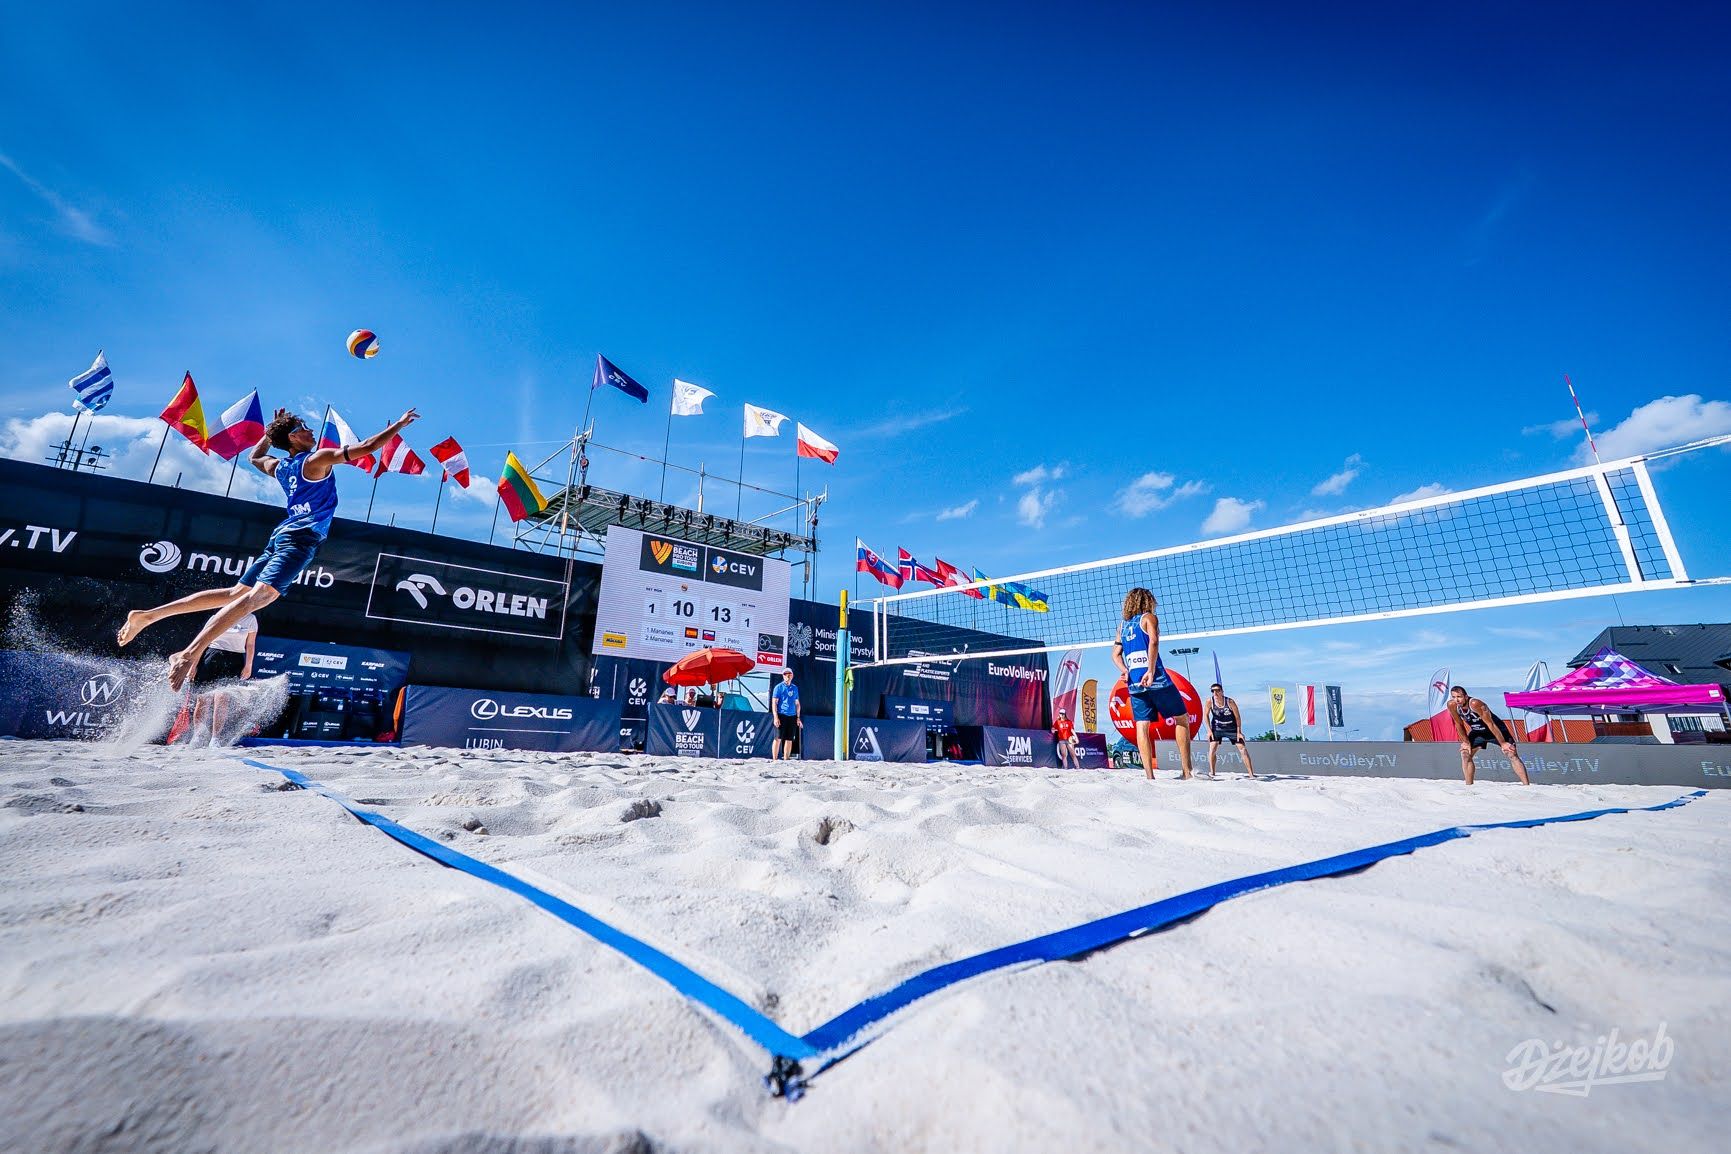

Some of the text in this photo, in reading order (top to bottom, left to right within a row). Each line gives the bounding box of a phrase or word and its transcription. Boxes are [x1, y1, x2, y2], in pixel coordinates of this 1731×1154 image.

[730, 562, 755, 576] CEV
[452, 586, 547, 619] ORLEN
[648, 603, 655, 613] 1
[673, 600, 694, 617] 10
[711, 606, 731, 623] 13
[744, 618, 750, 628] 1
[815, 640, 836, 651] Sport
[1133, 657, 1148, 665] cap
[988, 662, 1047, 683] EuroVolley.TV
[628, 697, 647, 706] CEV
[500, 704, 573, 720] LEXUS
[620, 728, 632, 736] CZ
[465, 738, 504, 750] LUBIN
[675, 735, 704, 744] BEACH
[1008, 736, 1032, 755] ZAM
[735, 745, 754, 754] CEV
[1074, 747, 1086, 760] ap
[1009, 755, 1033, 763] SERVICES
[1299, 753, 1397, 769] EuroVolley.TV
[1700, 761, 1731, 777] Eu
